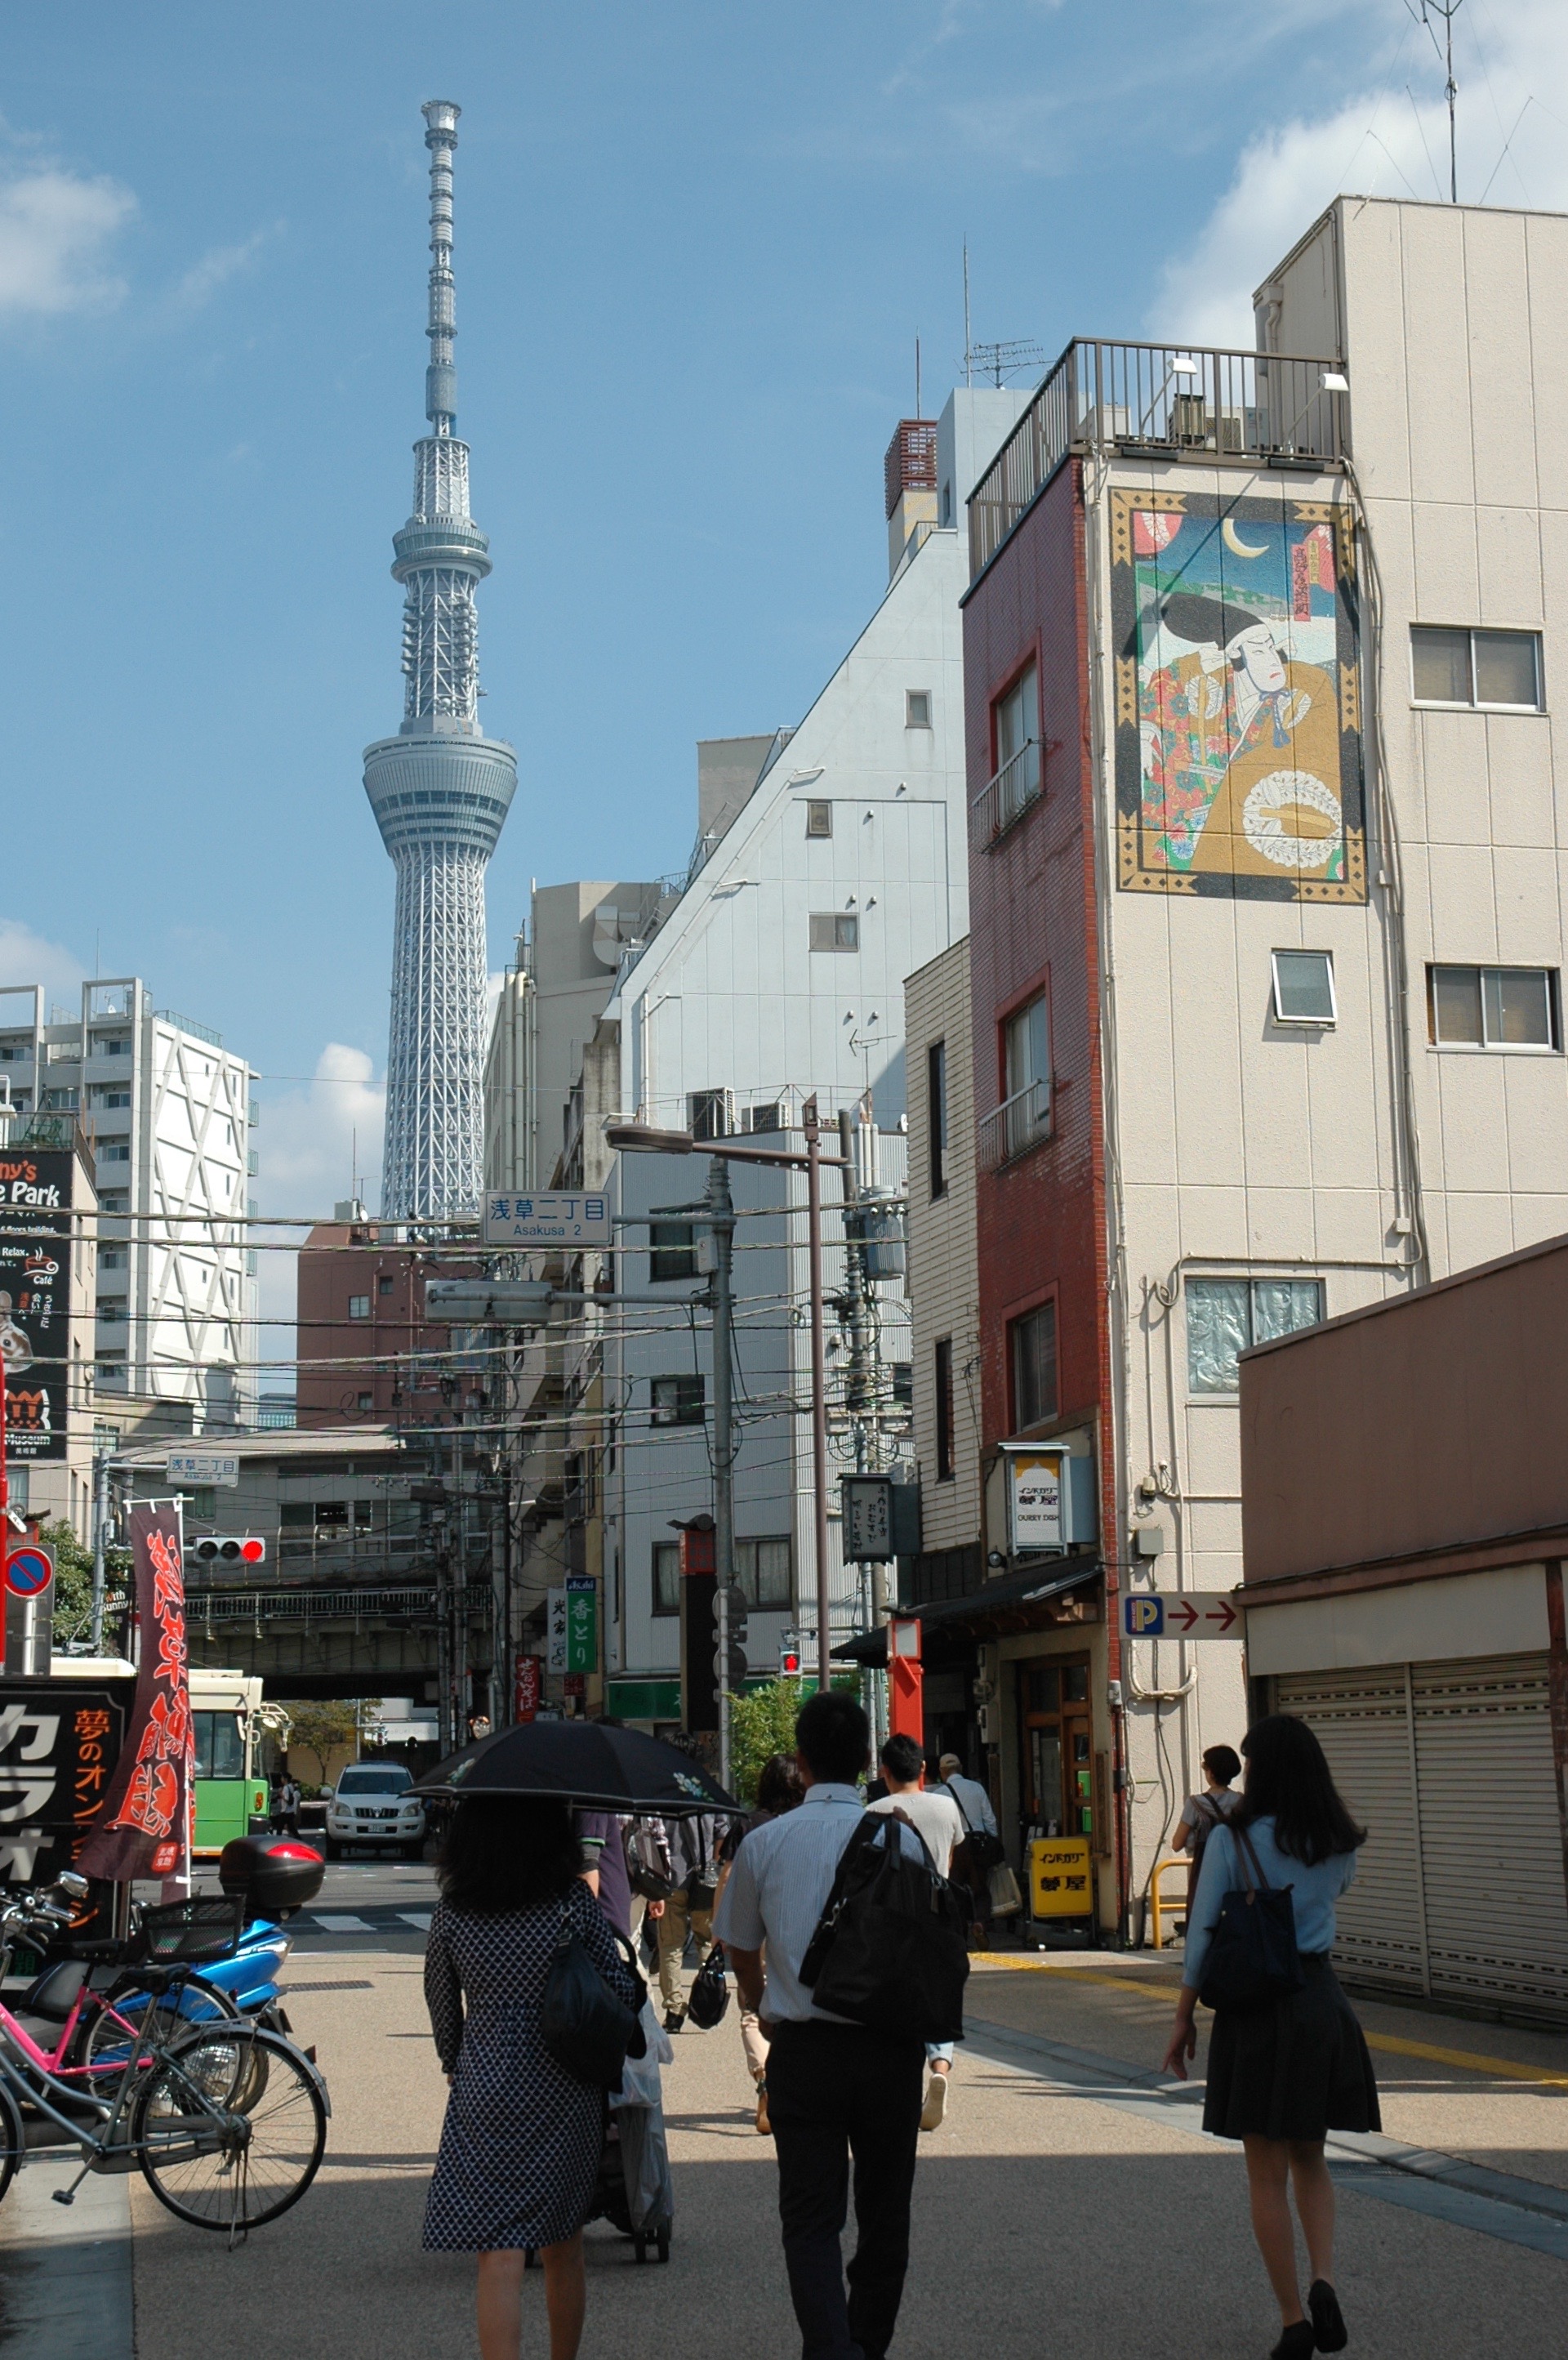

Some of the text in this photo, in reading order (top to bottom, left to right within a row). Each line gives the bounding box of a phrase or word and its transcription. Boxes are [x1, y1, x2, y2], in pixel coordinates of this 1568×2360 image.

[11, 1181, 60, 1207] Park
[490, 1198, 604, 1220] 浅草二丁目
[513, 1224, 581, 1236] Asakusa 2
[2, 1247, 29, 1256] Relax.
[33, 1275, 52, 1285] Café
[5, 1434, 51, 1445] Museum
[172, 1459, 234, 1472] 浅草二丁目
[568, 1580, 594, 1590] Asahi
[572, 1598, 592, 1666] 香とり
[1040, 1852, 1085, 1863] インドカリー
[1040, 1875, 1086, 1892] 夢屋
